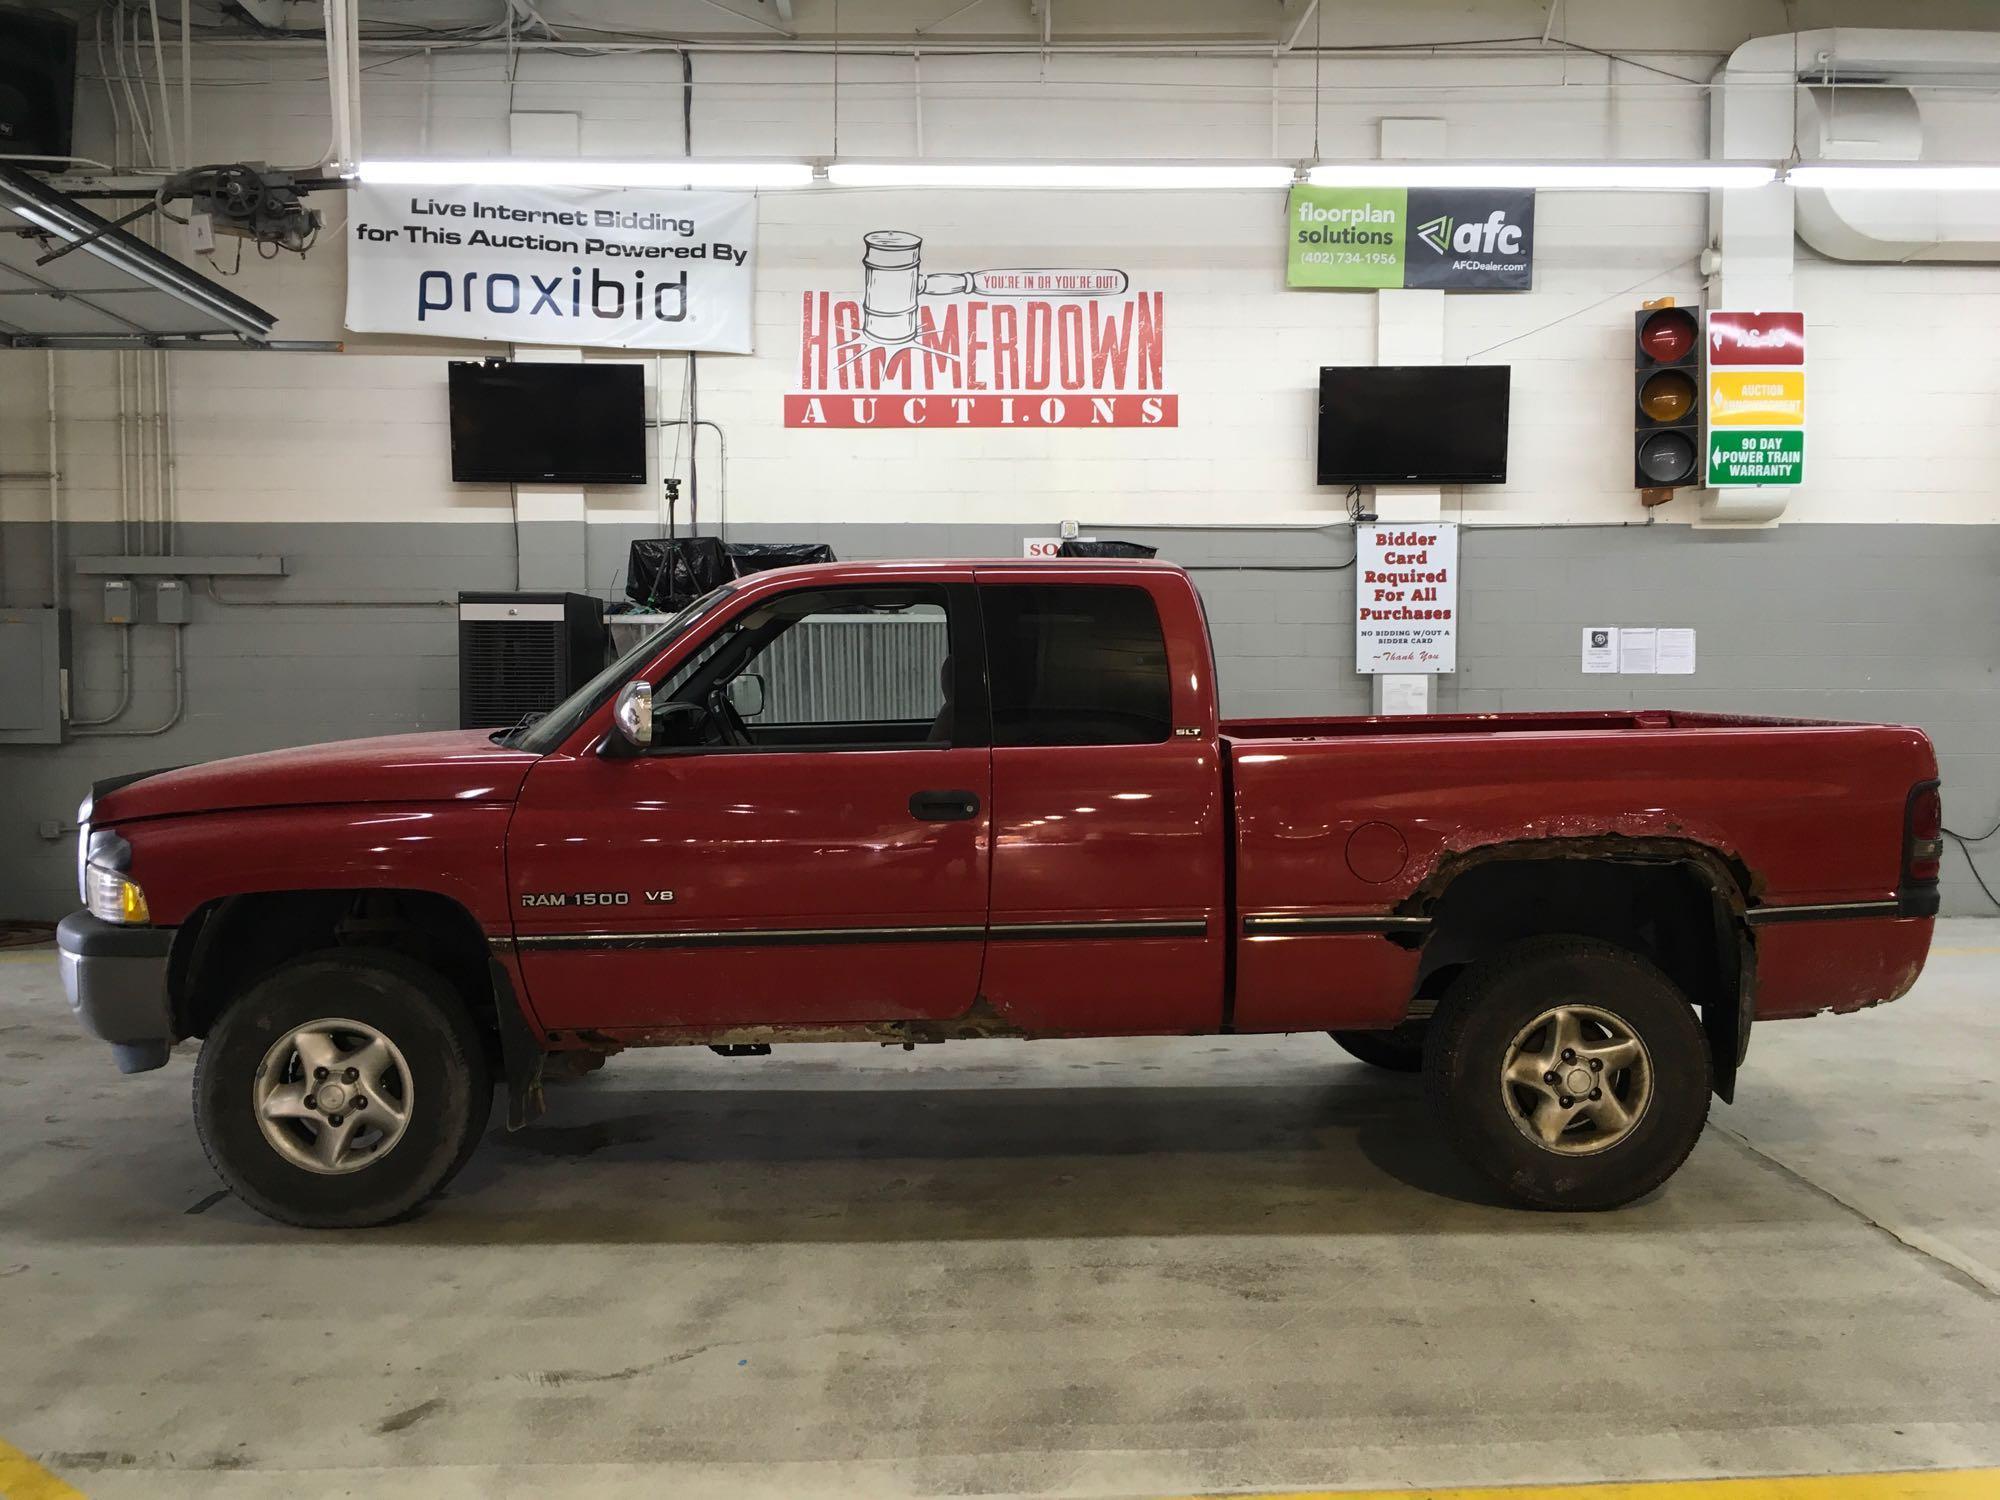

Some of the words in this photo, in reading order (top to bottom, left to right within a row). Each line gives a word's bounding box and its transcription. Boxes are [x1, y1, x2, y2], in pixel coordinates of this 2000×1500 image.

[411, 198, 467, 218] Live
[473, 201, 588, 227] Internet
[594, 210, 695, 238] Bidding
[1298, 202, 1396, 227] floorplan
[1297, 225, 1394, 246] solutions
[1453, 210, 1523, 255] afc
[356, 223, 399, 242] for
[403, 225, 462, 246] This
[468, 230, 579, 254] Auction
[585, 238, 707, 260] Powered
[712, 243, 748, 267] By
[1301, 252, 1335, 266] (402)
[1337, 252, 1397, 266] 734-1956
[984, 275, 1020, 289] YOU'RE
[1024, 275, 1034, 289] IN
[1038, 275, 1051, 289] OR
[1055, 275, 1092, 289] YOU'RE
[1096, 275, 1119, 289] OUT!
[418, 266, 687, 322] proxibid
[1741, 438, 1758, 449] 90
[1760, 438, 1783, 449] DAY
[1722, 452, 1767, 463] POWER
[1768, 452, 1800, 463] TRAIN
[1729, 464, 1793, 477] WARRANTY
[1375, 531, 1437, 546] Bidder
[1384, 550, 1428, 565] Card
[1364, 568, 1447, 587] Required
[1374, 589, 1405, 602] For
[1411, 587, 1437, 602] All
[1360, 606, 1452, 621] Purchases
[1413, 629, 1442, 638] W/OUT
[1419, 650, 1440, 662] You
[522, 894, 565, 907] RAM
[574, 893, 629, 906] 1500
[645, 890, 674, 901] V8
